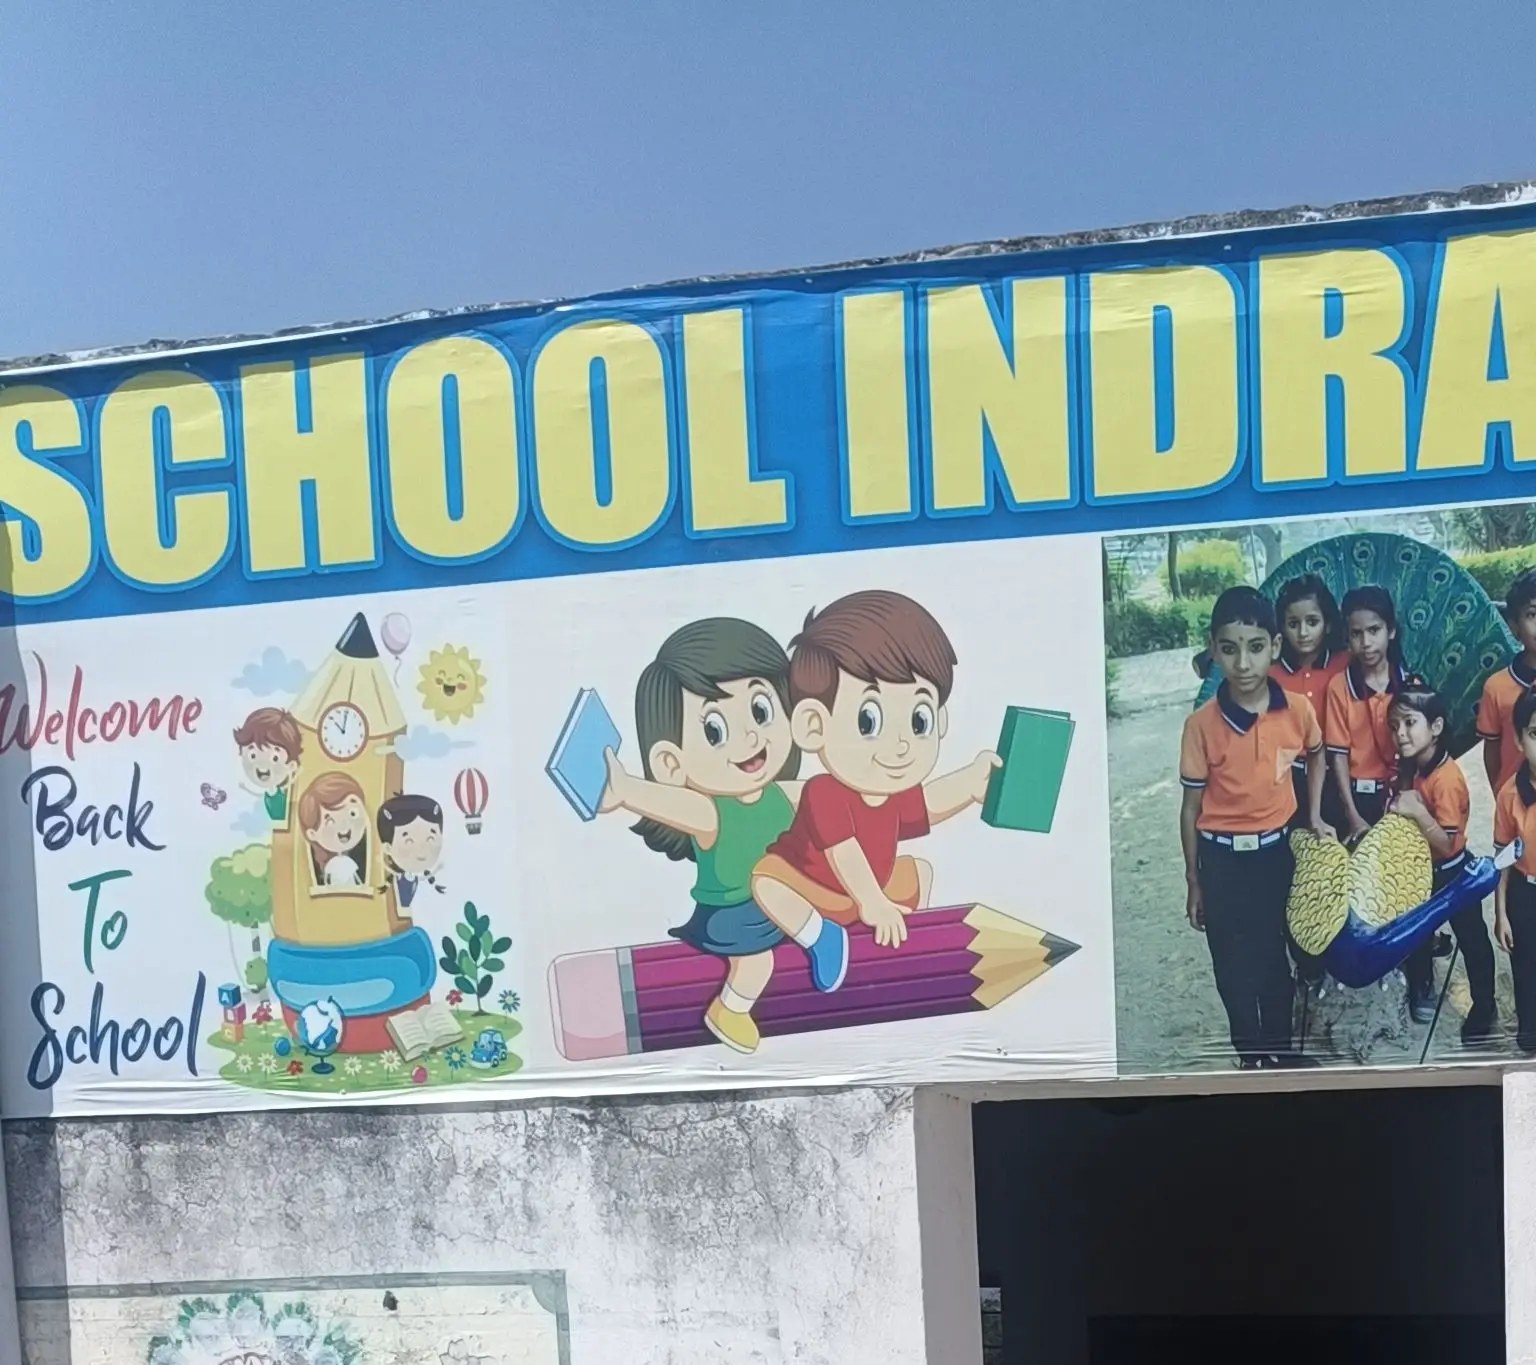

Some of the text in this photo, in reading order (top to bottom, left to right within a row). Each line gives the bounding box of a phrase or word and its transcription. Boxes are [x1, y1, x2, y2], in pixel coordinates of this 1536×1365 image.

[0, 304, 792, 602] SCHOOL
[0, 650, 203, 761] Welcome
[21, 761, 167, 851] Back
[68, 869, 132, 974] To
[27, 970, 206, 1090] School
